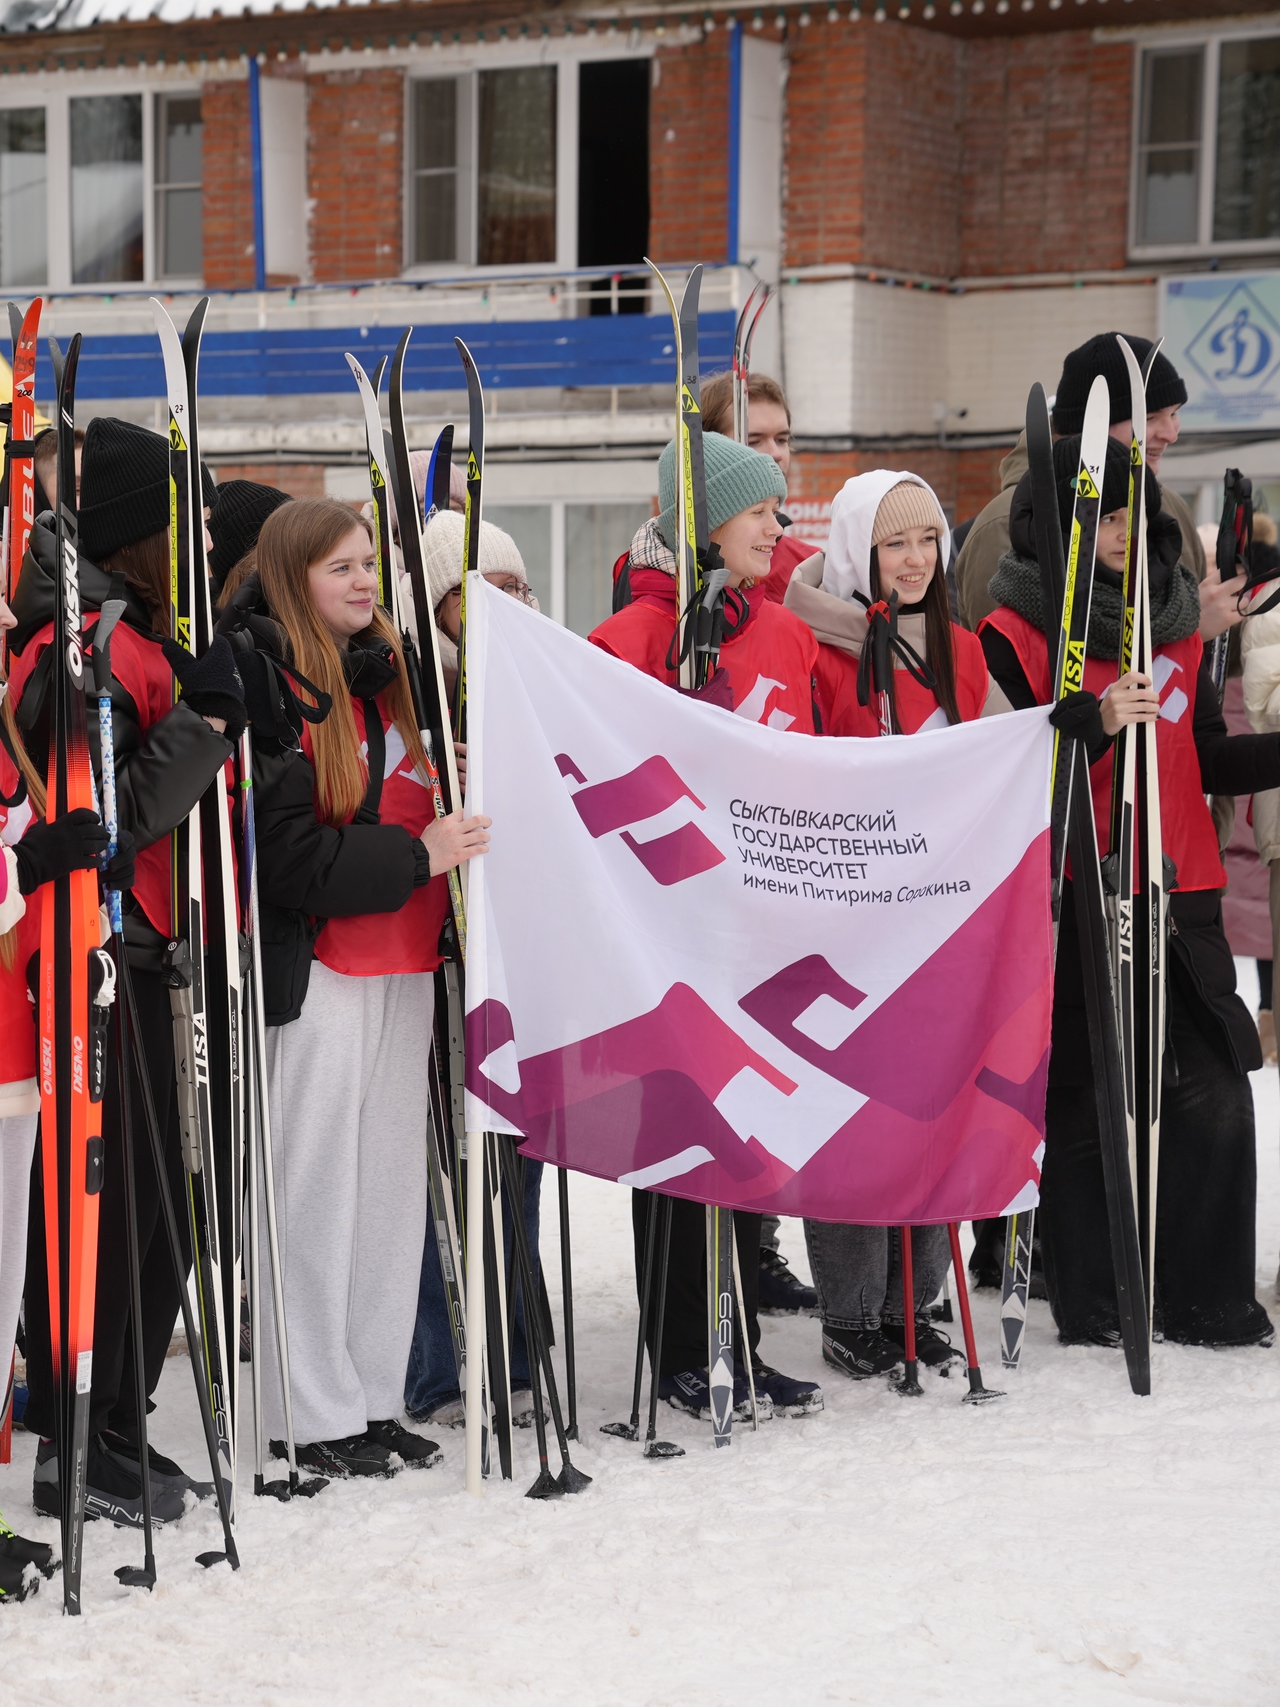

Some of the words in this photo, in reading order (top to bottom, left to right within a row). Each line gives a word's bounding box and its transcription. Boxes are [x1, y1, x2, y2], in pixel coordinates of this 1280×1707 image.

[17, 389, 32, 398] 200
[687, 375, 697, 384] 38
[175, 404, 184, 413] 27
[682, 430, 694, 510] UNIVERSAL
[1090, 466, 1099, 474] 31
[685, 513, 695, 542] TOP
[1063, 595, 1071, 623] TOP
[1068, 533, 1078, 591] SKATING
[729, 799, 897, 832] СЫКТЫВКАРСКИЙ
[733, 823, 928, 856] ГОСУДАРСТВЕННЫЙ
[738, 846, 867, 880] УНИВЕРСИТЕТ
[743, 873, 799, 897] имени
[802, 882, 892, 907] Питирима
[897, 880, 971, 904] Сорокина
[1120, 900, 1132, 965] TISA
[193, 1012, 209, 1089] TISA
[1013, 1235, 1030, 1291] 177
[718, 1292, 732, 1355] 199
[822, 1334, 875, 1372] SPINE
[213, 1383, 229, 1446] 192
[317, 1442, 353, 1472] PINE
[85, 1493, 166, 1524] PINE
